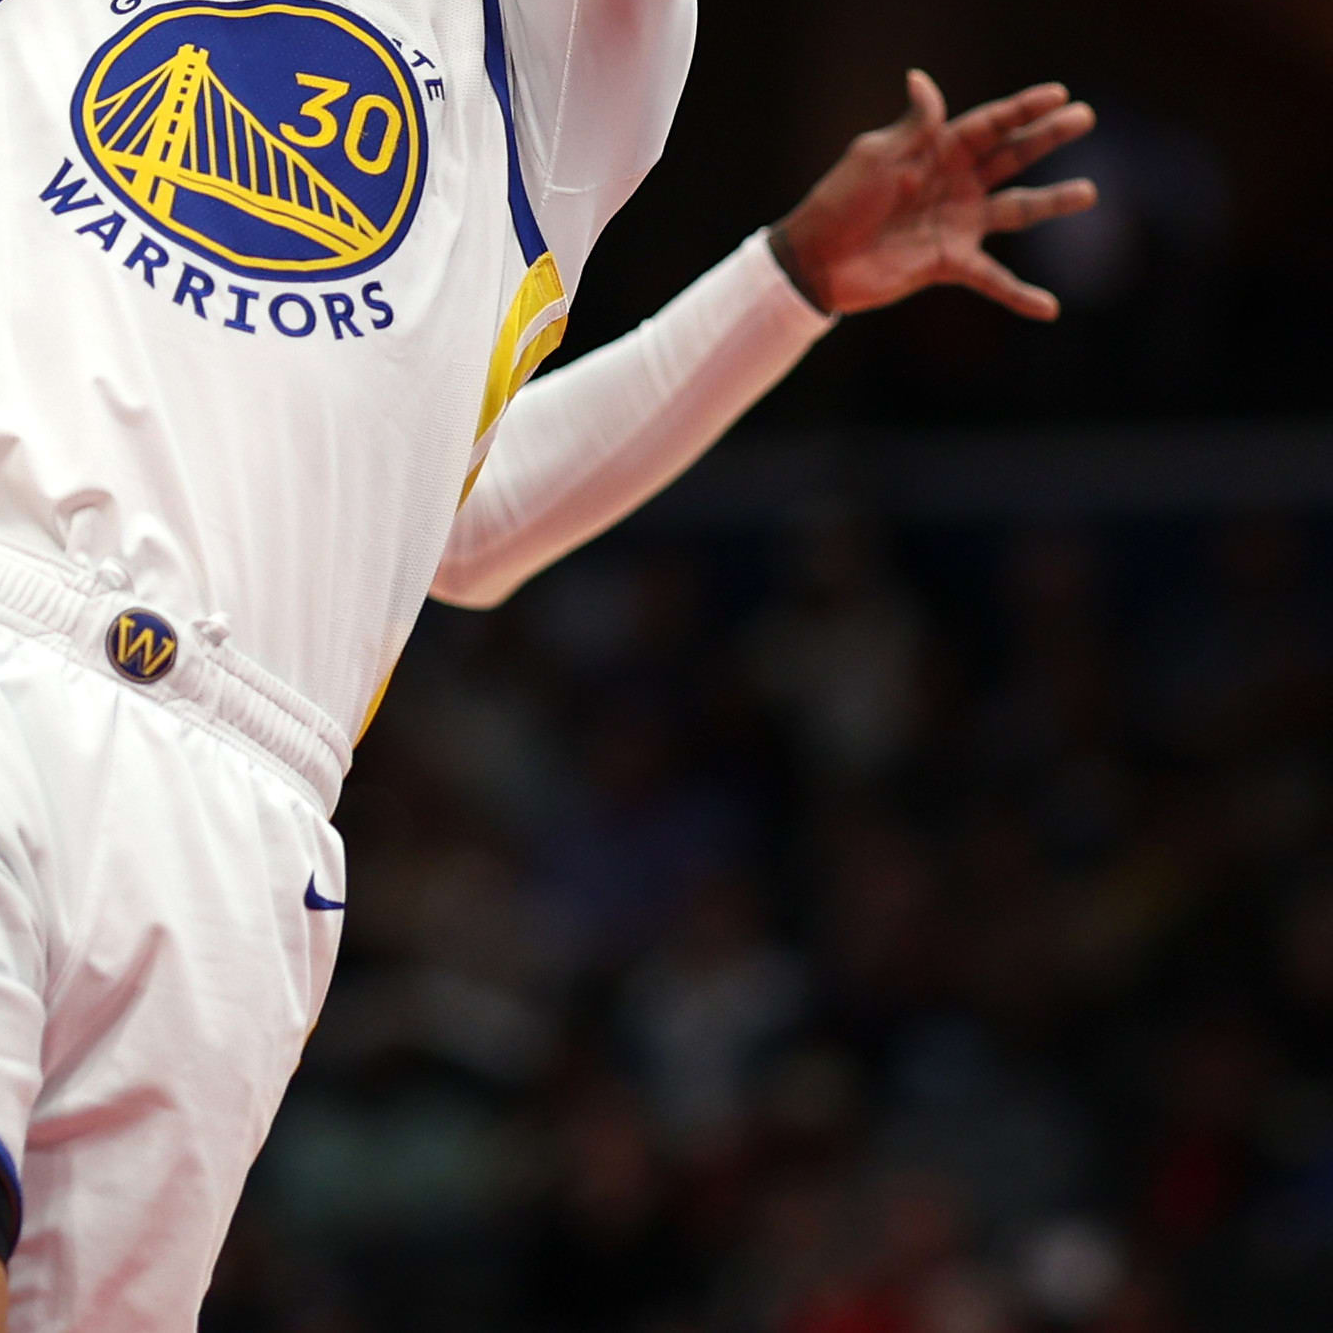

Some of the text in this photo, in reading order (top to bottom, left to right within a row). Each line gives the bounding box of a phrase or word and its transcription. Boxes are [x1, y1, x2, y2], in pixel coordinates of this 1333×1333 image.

[278, 72, 402, 175] 30
[39, 157, 395, 341] WARRIORS
[117, 614, 176, 677] W
